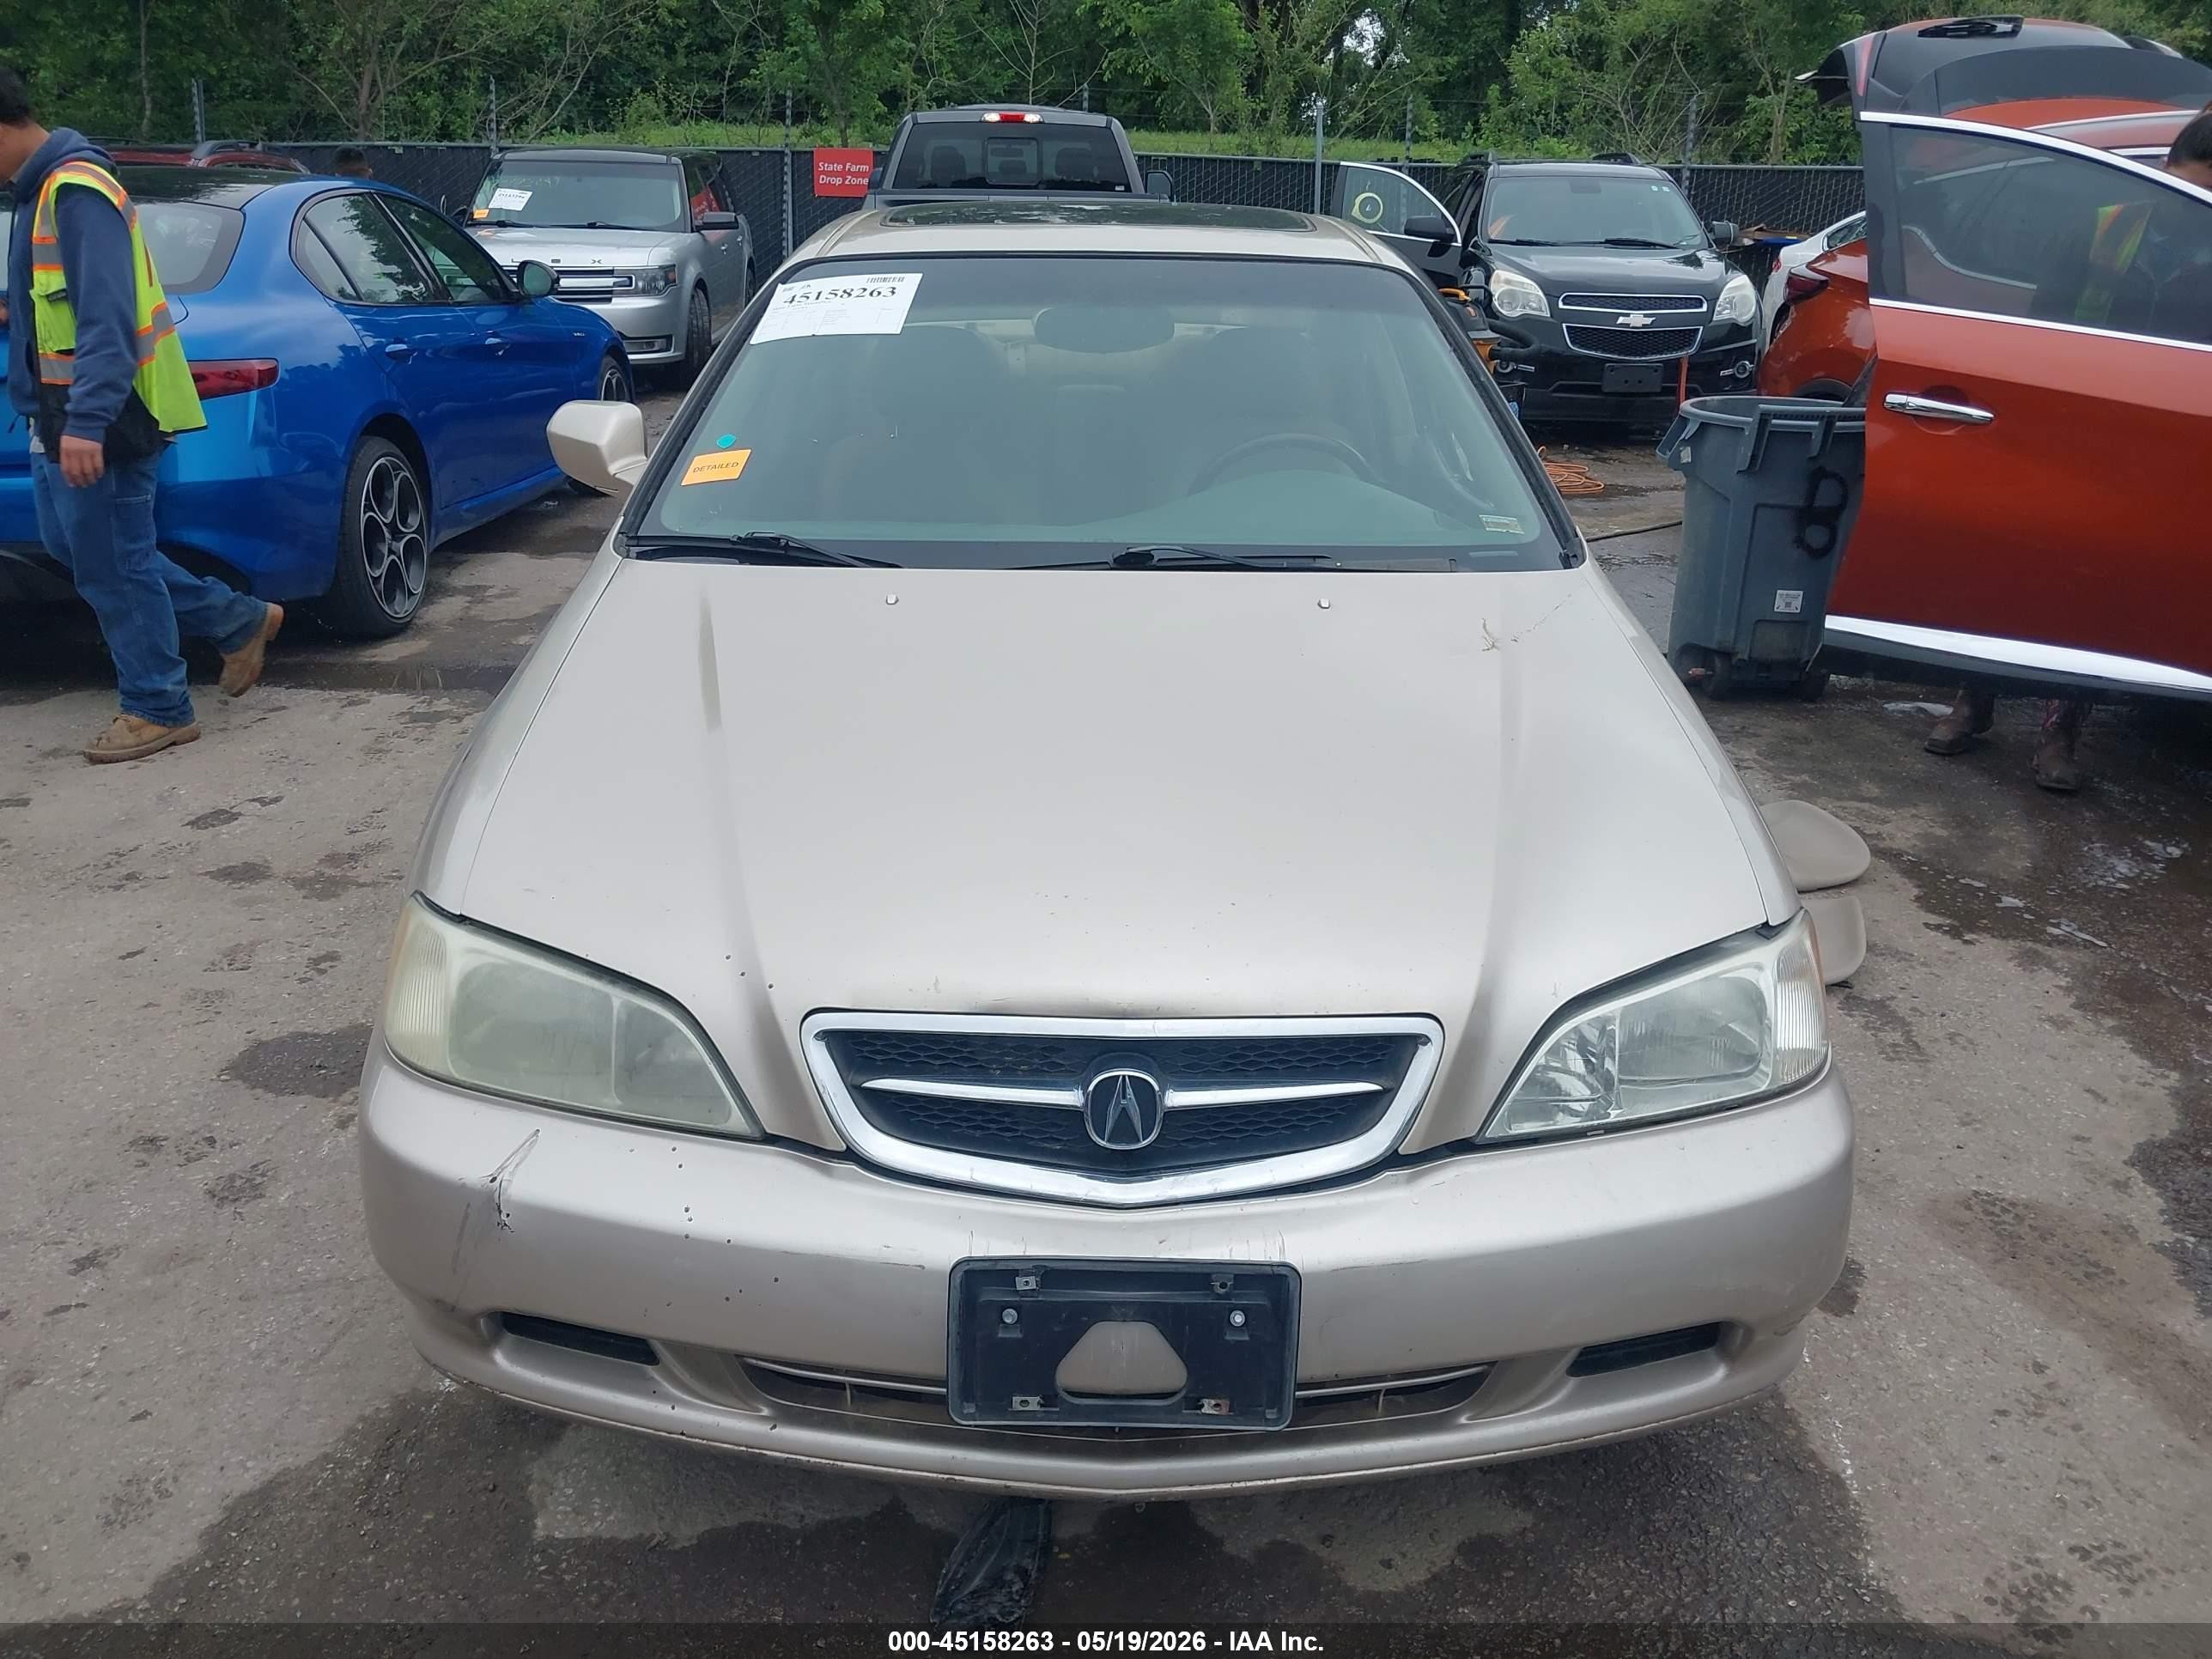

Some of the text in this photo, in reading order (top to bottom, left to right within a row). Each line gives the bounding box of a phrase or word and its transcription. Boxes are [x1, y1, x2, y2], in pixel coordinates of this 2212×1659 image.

[818, 161, 869, 173] State Farm
[819, 174, 869, 185] Drop Zone
[783, 286, 897, 304] 45158263
[692, 462, 739, 473] DETAILED
